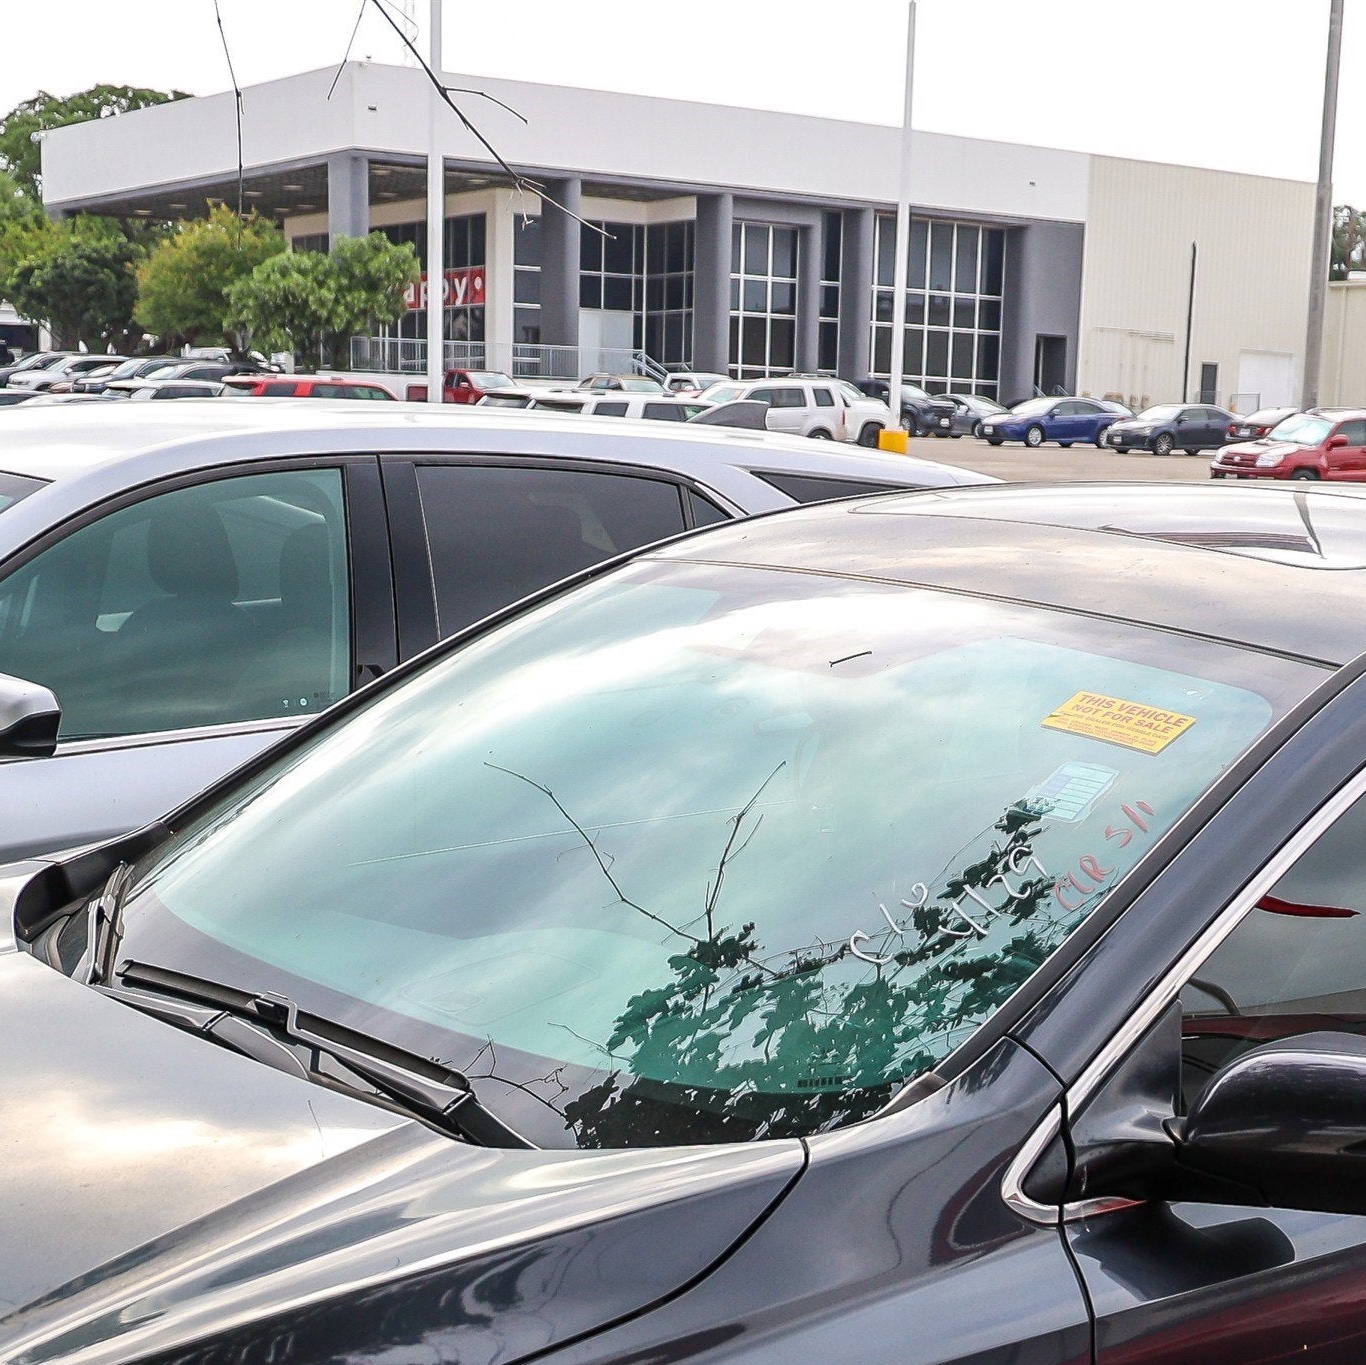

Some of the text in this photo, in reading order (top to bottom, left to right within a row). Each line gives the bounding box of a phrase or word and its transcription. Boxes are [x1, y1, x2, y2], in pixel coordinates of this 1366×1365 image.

[1071, 703, 1175, 734] NOT FOR SALE
[1078, 694, 1188, 728] THIS VEHICLE
